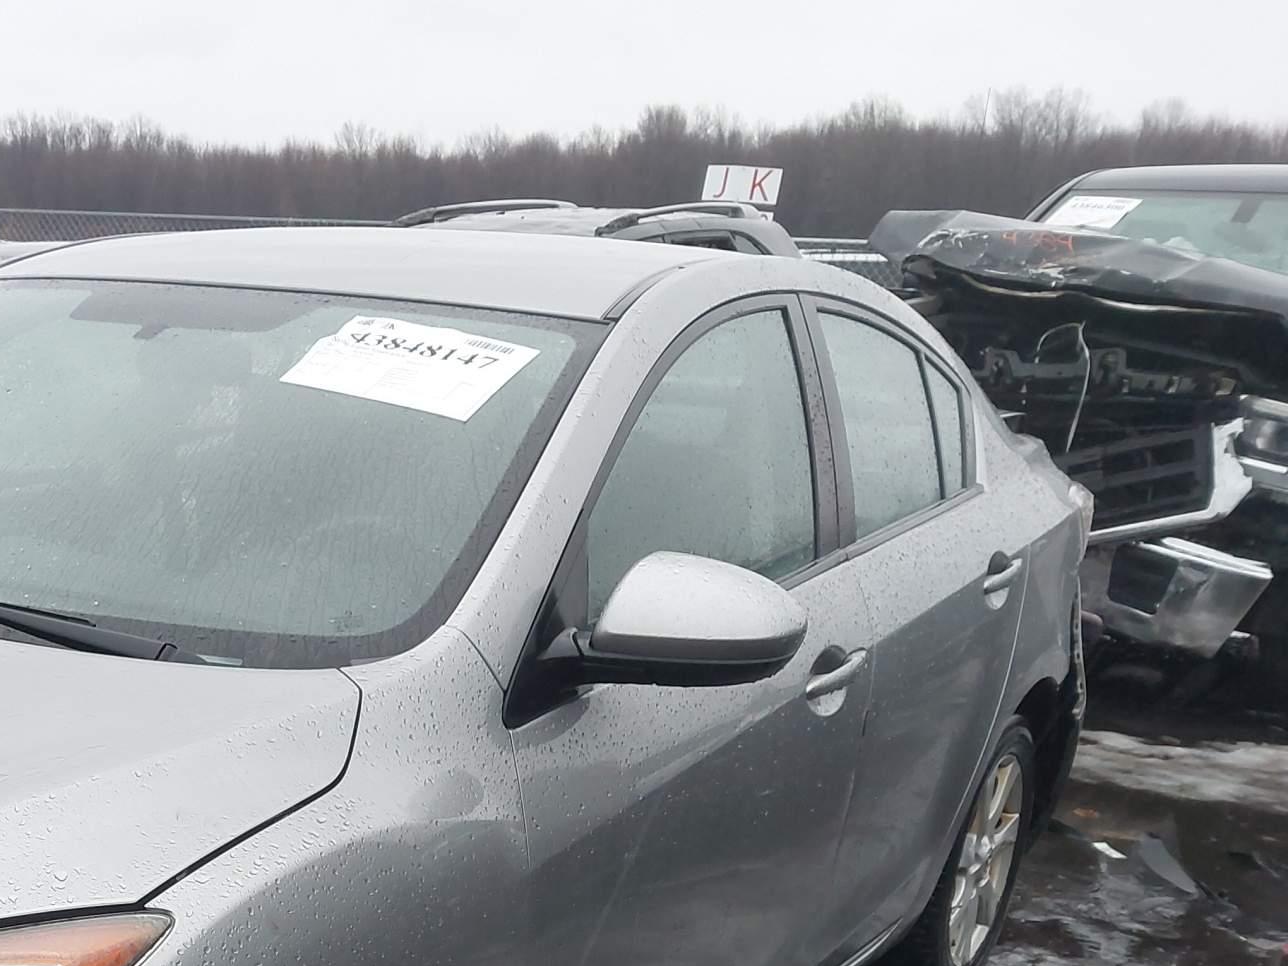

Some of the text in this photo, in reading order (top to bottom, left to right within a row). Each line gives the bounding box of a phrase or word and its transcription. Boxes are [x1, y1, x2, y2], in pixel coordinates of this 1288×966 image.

[713, 167, 773, 201] J K
[350, 331, 500, 369] 43848147
